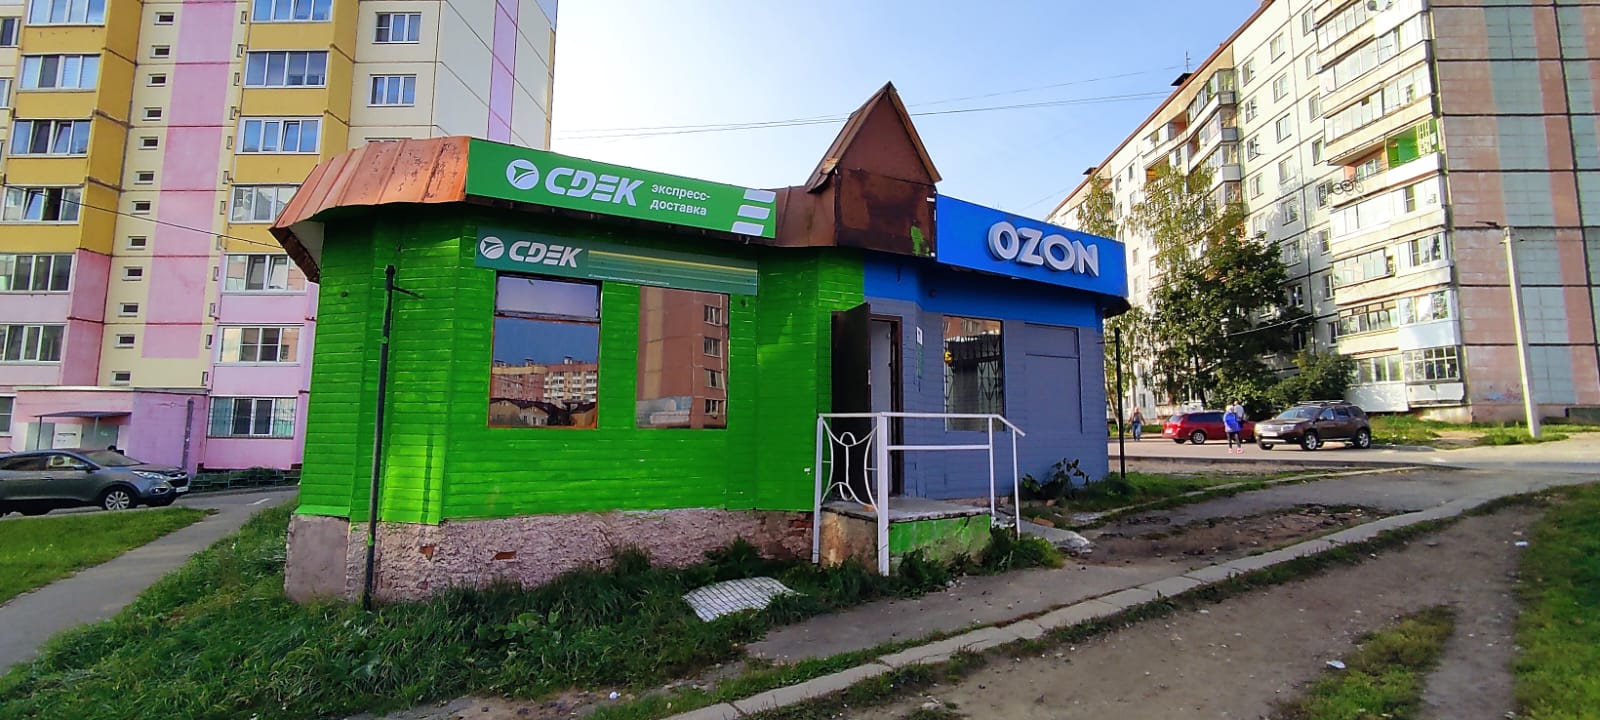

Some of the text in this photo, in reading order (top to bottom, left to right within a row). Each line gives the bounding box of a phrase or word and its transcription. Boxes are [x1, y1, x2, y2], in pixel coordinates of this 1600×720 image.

[651, 184, 711, 201] экспресс-
[650, 199, 707, 216] доставка
[988, 221, 1100, 277] OZON
